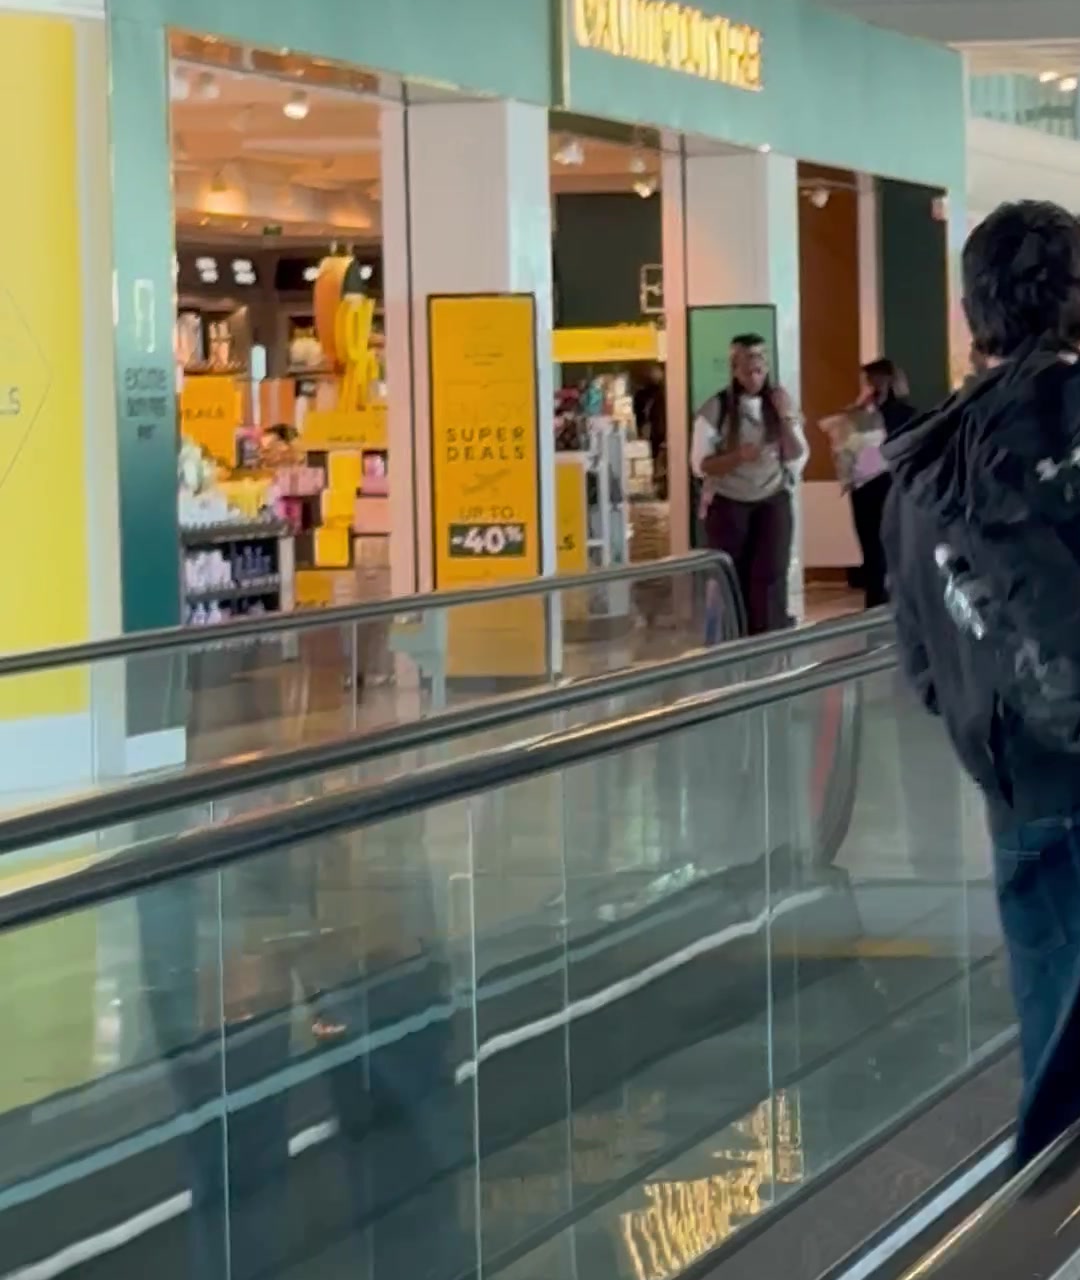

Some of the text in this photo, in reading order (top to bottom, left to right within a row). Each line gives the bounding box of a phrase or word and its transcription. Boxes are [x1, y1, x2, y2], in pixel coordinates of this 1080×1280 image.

[446, 426, 525, 443] SUPER
[446, 447, 525, 464] DEALS
[459, 506, 515, 519] UP TO
